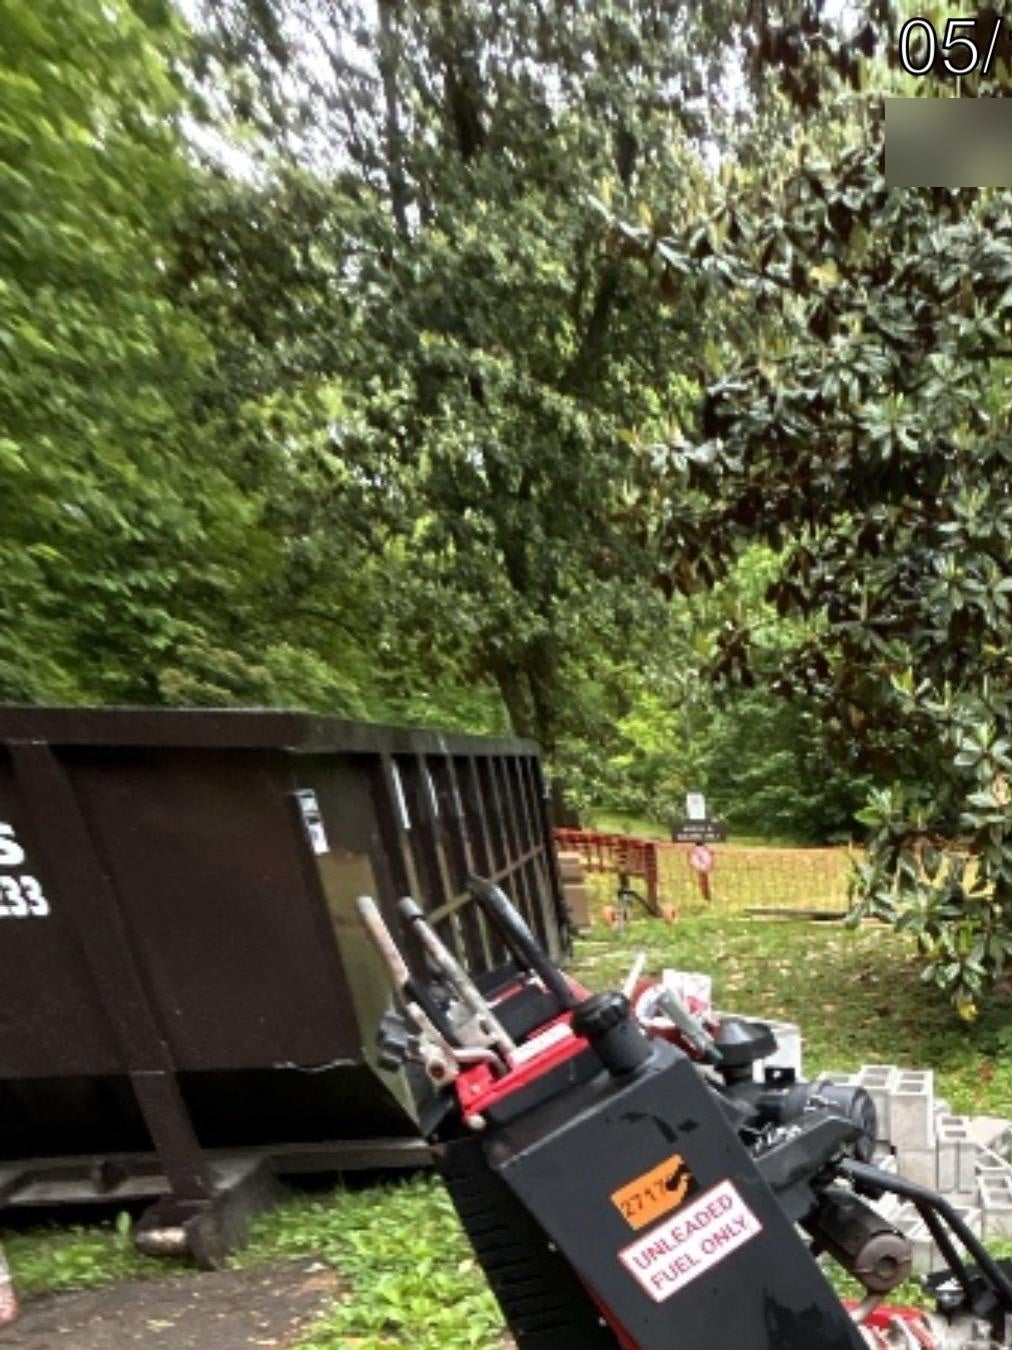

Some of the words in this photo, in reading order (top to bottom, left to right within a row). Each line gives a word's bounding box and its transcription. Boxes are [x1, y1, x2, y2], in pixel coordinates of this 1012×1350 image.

[632, 1193, 734, 1270] UNLEADED
[650, 1253, 701, 1291] FUEL
[701, 1213, 749, 1256] ONLY
